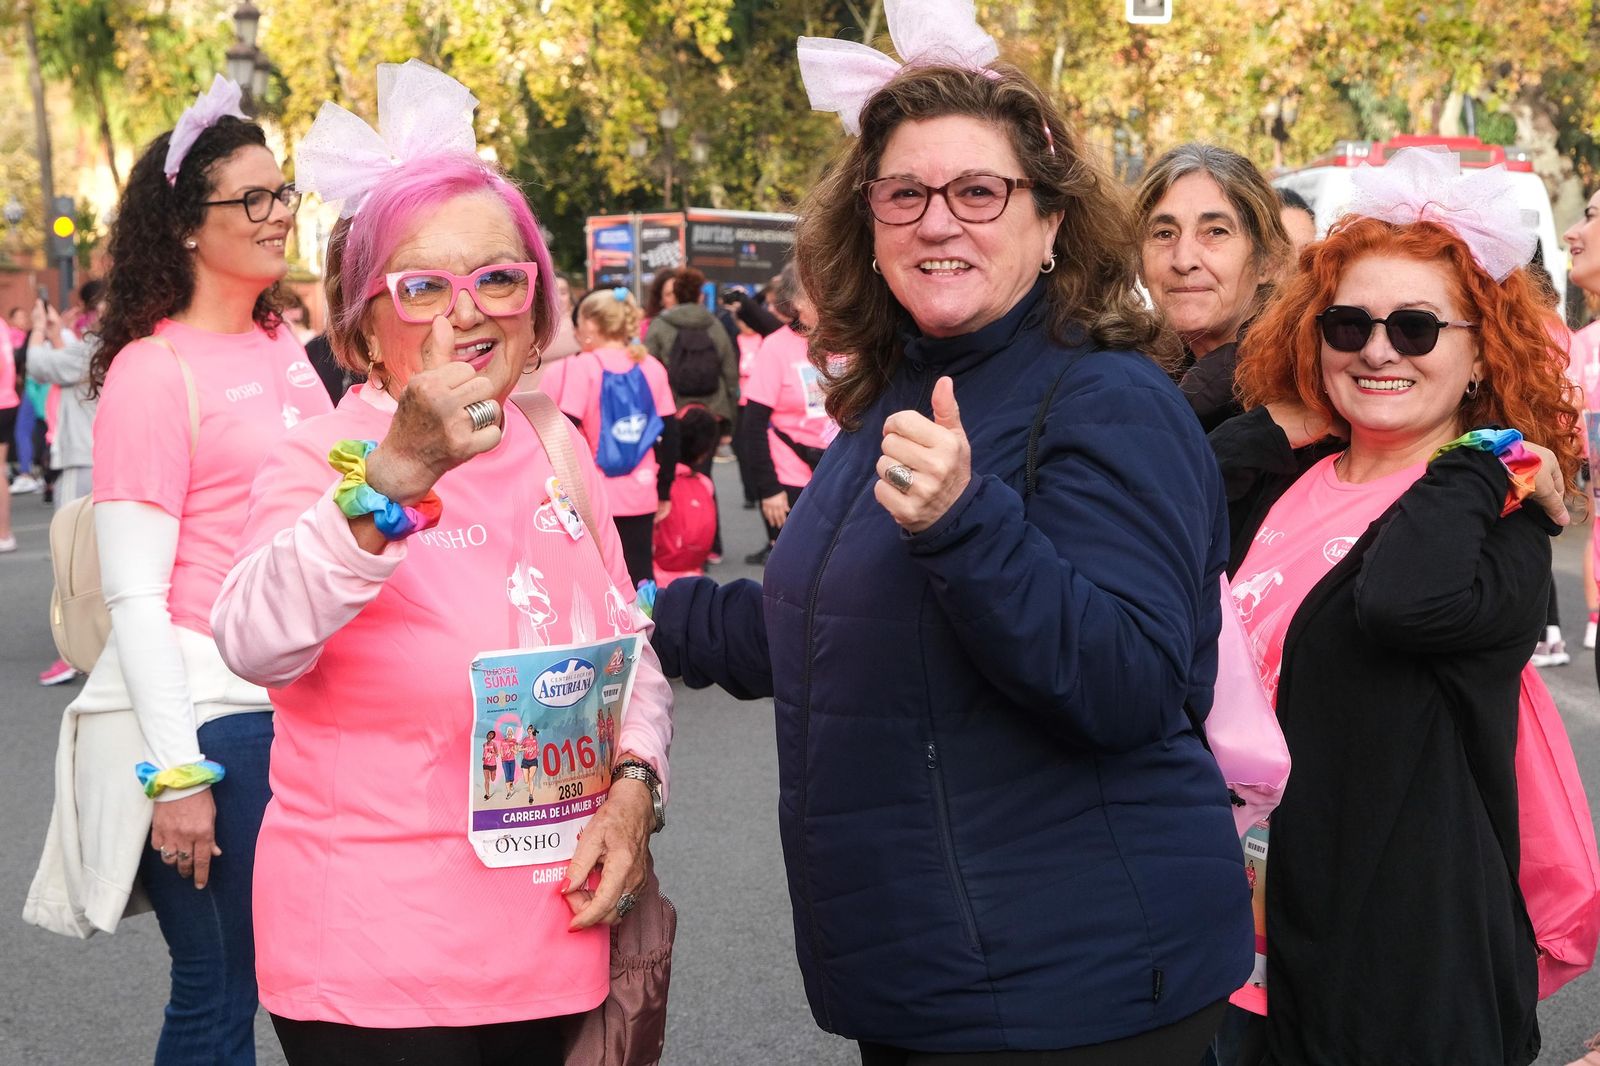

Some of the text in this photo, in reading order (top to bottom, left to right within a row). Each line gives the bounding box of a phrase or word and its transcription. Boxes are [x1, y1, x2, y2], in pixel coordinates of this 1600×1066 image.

[484, 674, 519, 689] SUMA
[486, 693, 518, 704] NO DO
[542, 735, 596, 777] 016
[558, 781, 584, 801] 2830
[502, 809, 548, 823] CARRERA
[549, 807, 560, 818] DE
[561, 804, 570, 816] LA
[571, 801, 592, 814] MUJER
[495, 832, 561, 854] OYSHO
